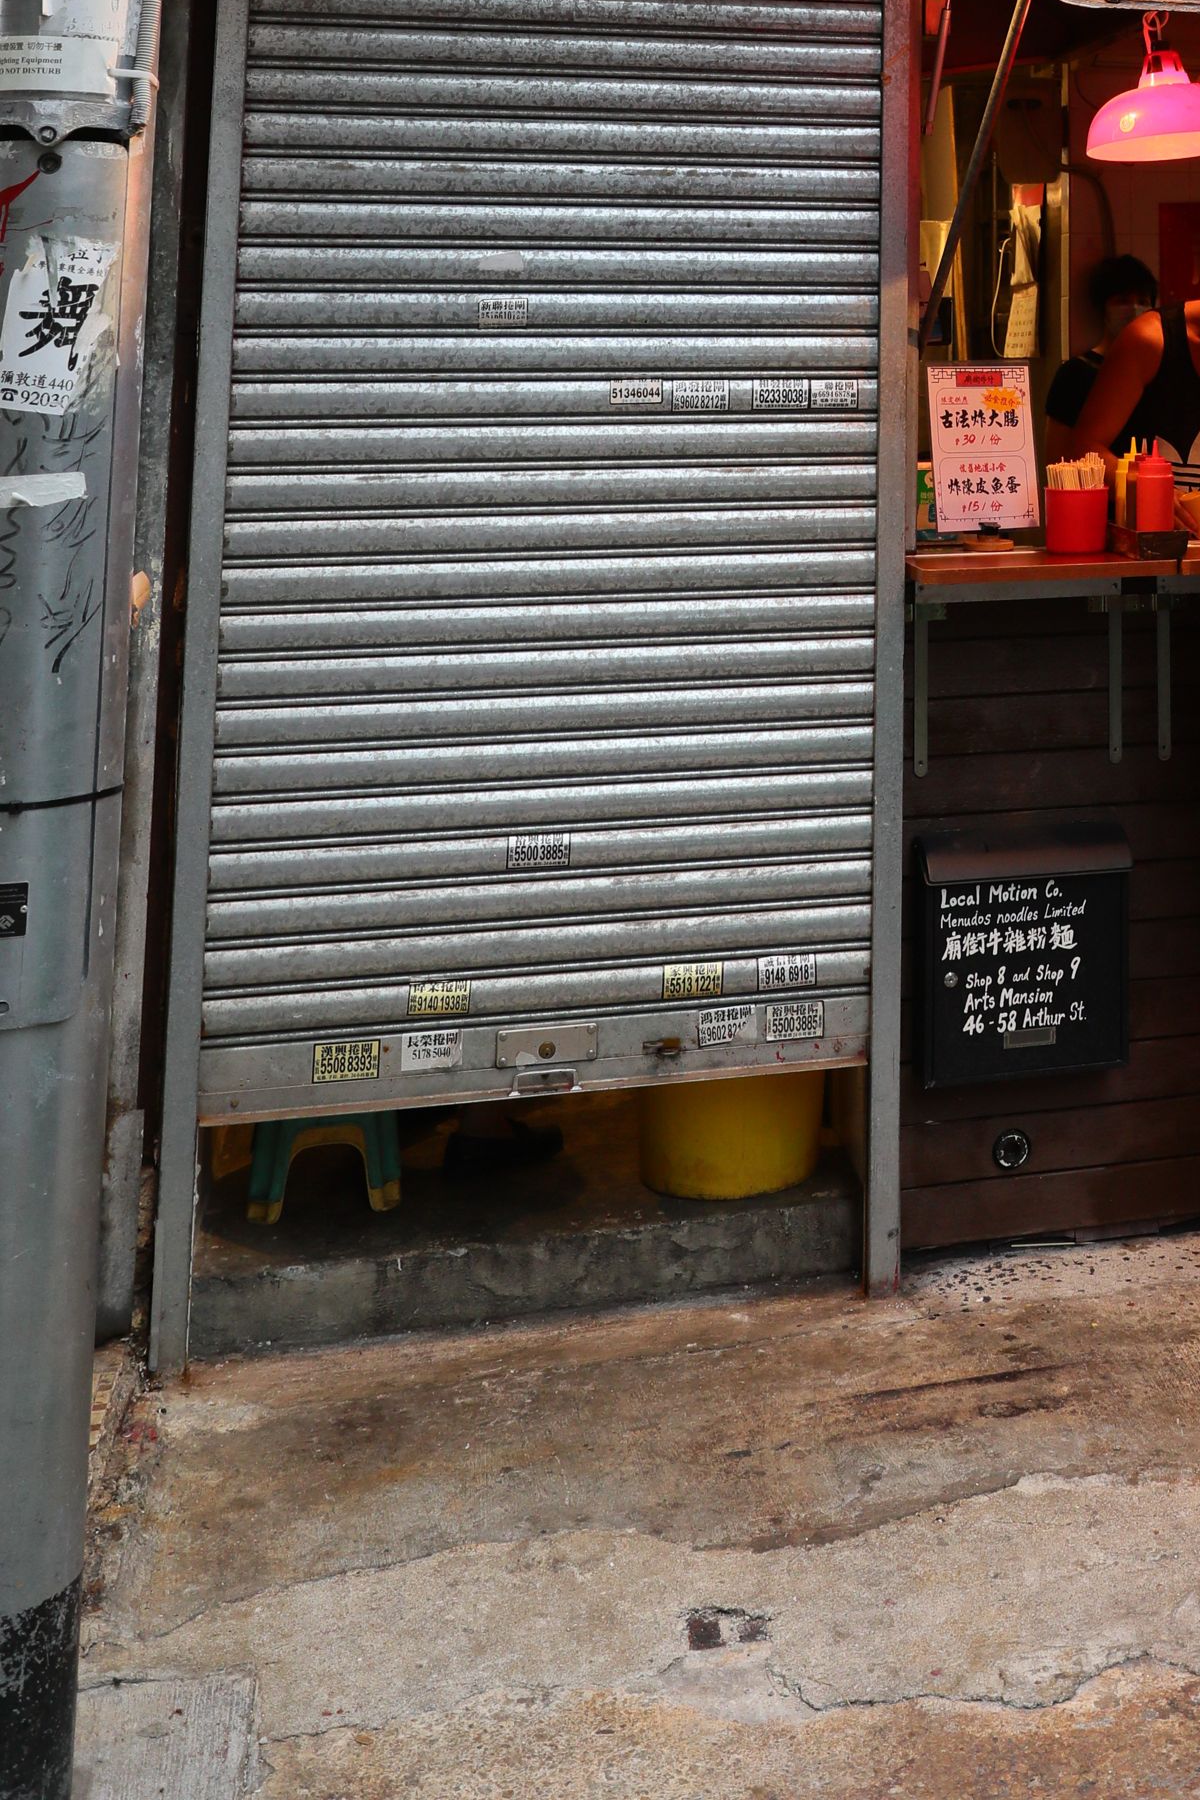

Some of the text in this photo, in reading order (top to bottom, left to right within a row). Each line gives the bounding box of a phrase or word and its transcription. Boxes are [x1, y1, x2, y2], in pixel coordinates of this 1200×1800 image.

[0, 57, 63, 65] ghting Equipment
[612, 388, 660, 399] 51346044
[940, 408, 1019, 429] 古法炸大腸
[948, 475, 1021, 496] 炸陳皮魚蛋
[940, 880, 1063, 909] Local Motion Co.
[940, 899, 1087, 929] Menudos noodles Limited
[941, 922, 1078, 961] 廟街牛雜粉麵
[670, 977, 692, 993] 5513
[695, 975, 716, 992] 1221
[765, 966, 785, 985] 9148
[789, 964, 809, 982] 6918
[965, 956, 1081, 992] Shop 8 and Shop 9
[964, 988, 1053, 1013] Arts Mansion
[1022, 1008, 1066, 1028] Arthur
[1069, 1001, 1087, 1021] St.
[321, 1043, 373, 1058] 漢興捲閘
[408, 1032, 458, 1048] 長榮捲閘
